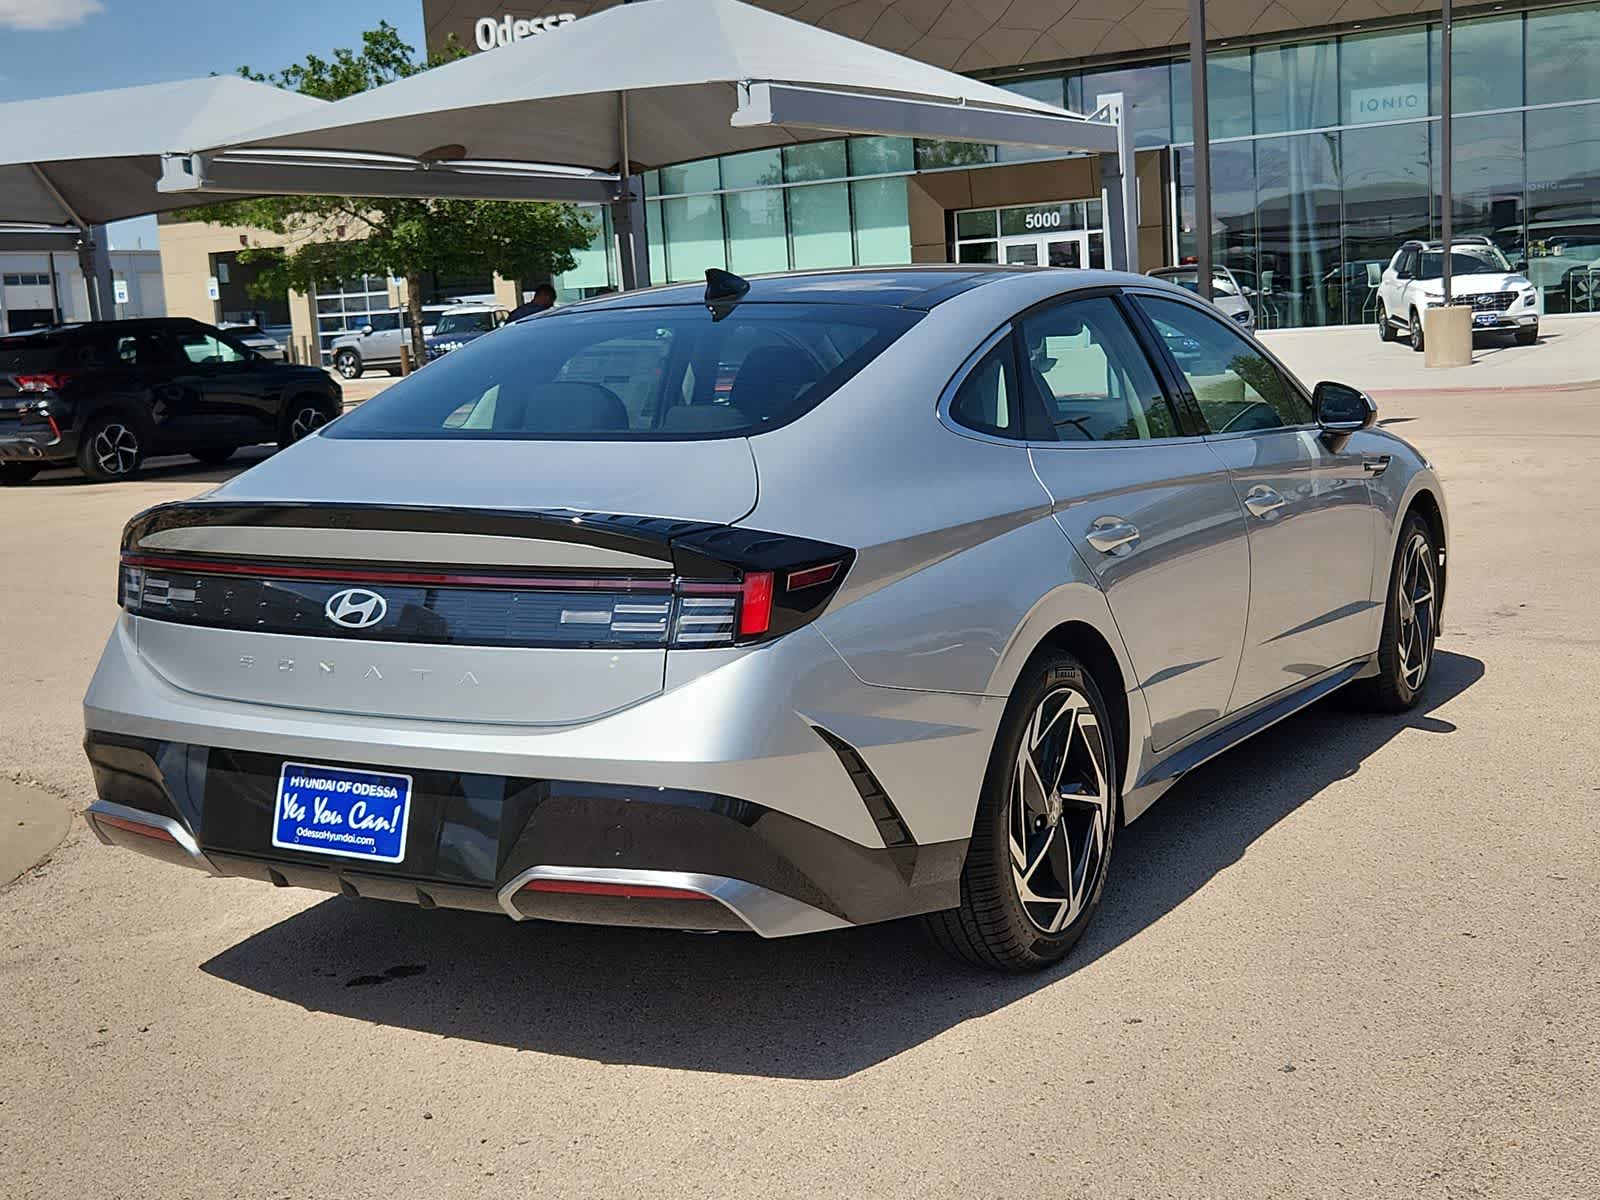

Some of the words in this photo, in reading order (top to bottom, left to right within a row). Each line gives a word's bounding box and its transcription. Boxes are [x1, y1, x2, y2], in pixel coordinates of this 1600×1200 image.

[1025, 211, 1060, 229] 5000
[239, 655, 480, 687] SONATA
[290, 775, 335, 792] HYUNDAI
[336, 781, 353, 793] OF
[352, 783, 398, 799] ODESSA
[282, 792, 307, 822] Yes
[313, 796, 343, 825] You
[348, 800, 401, 833] Can!
[296, 827, 375, 846] OdessaHyundai.com
